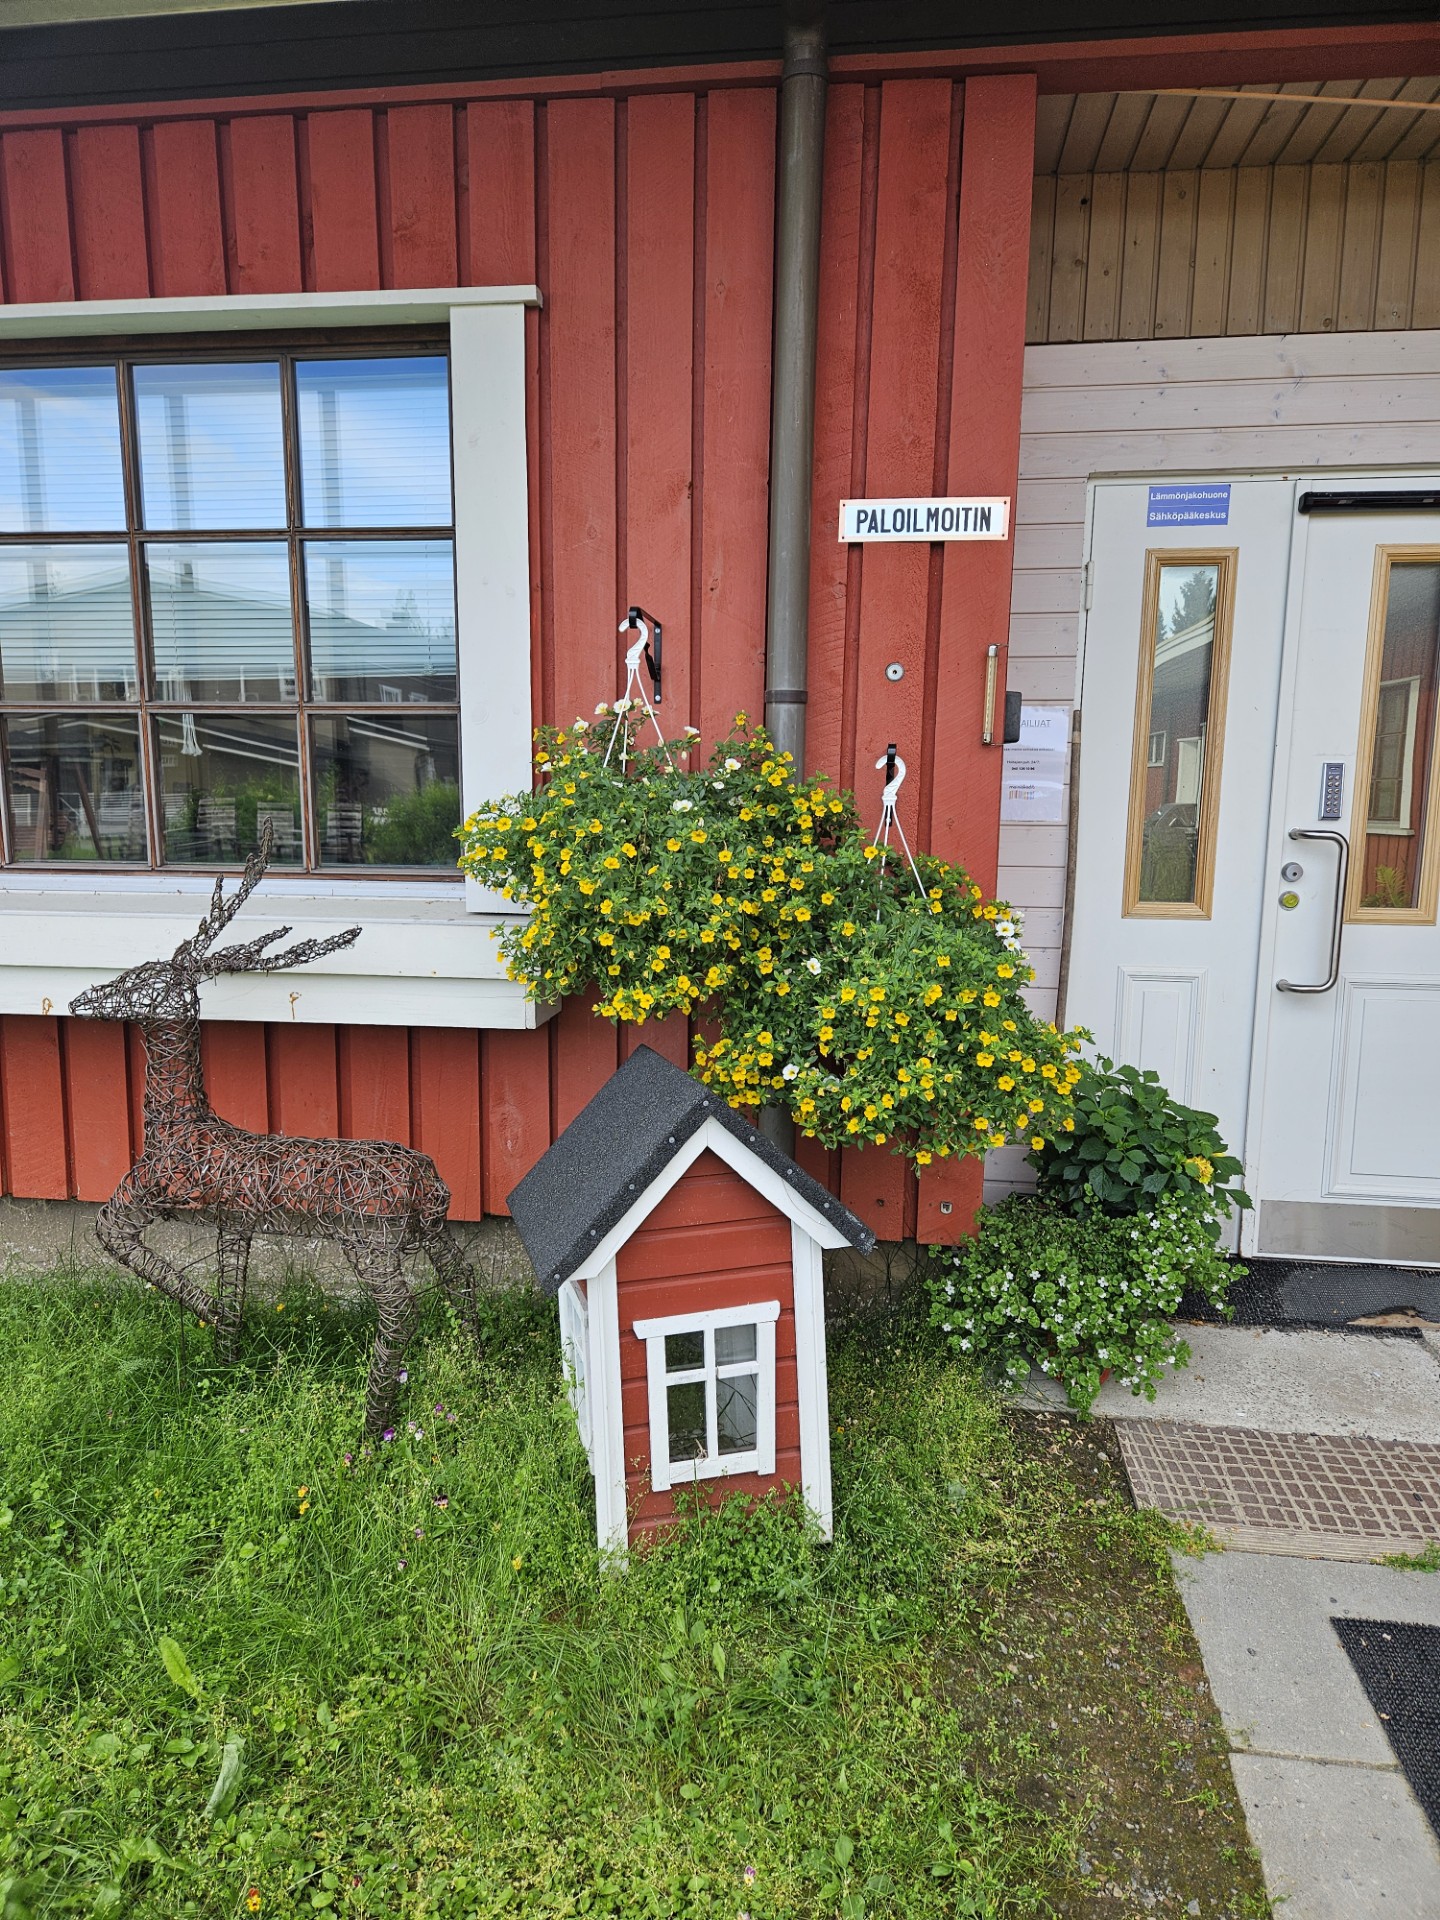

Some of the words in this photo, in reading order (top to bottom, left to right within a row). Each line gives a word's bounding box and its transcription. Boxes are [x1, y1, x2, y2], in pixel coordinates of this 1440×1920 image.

[1150, 492, 1228, 501] Lämmönjakohuone
[856, 507, 992, 533] PALOILMOITIN
[1149, 511, 1227, 521] Sähköpääkeskus
[1021, 719, 1052, 728] AILIJAT
